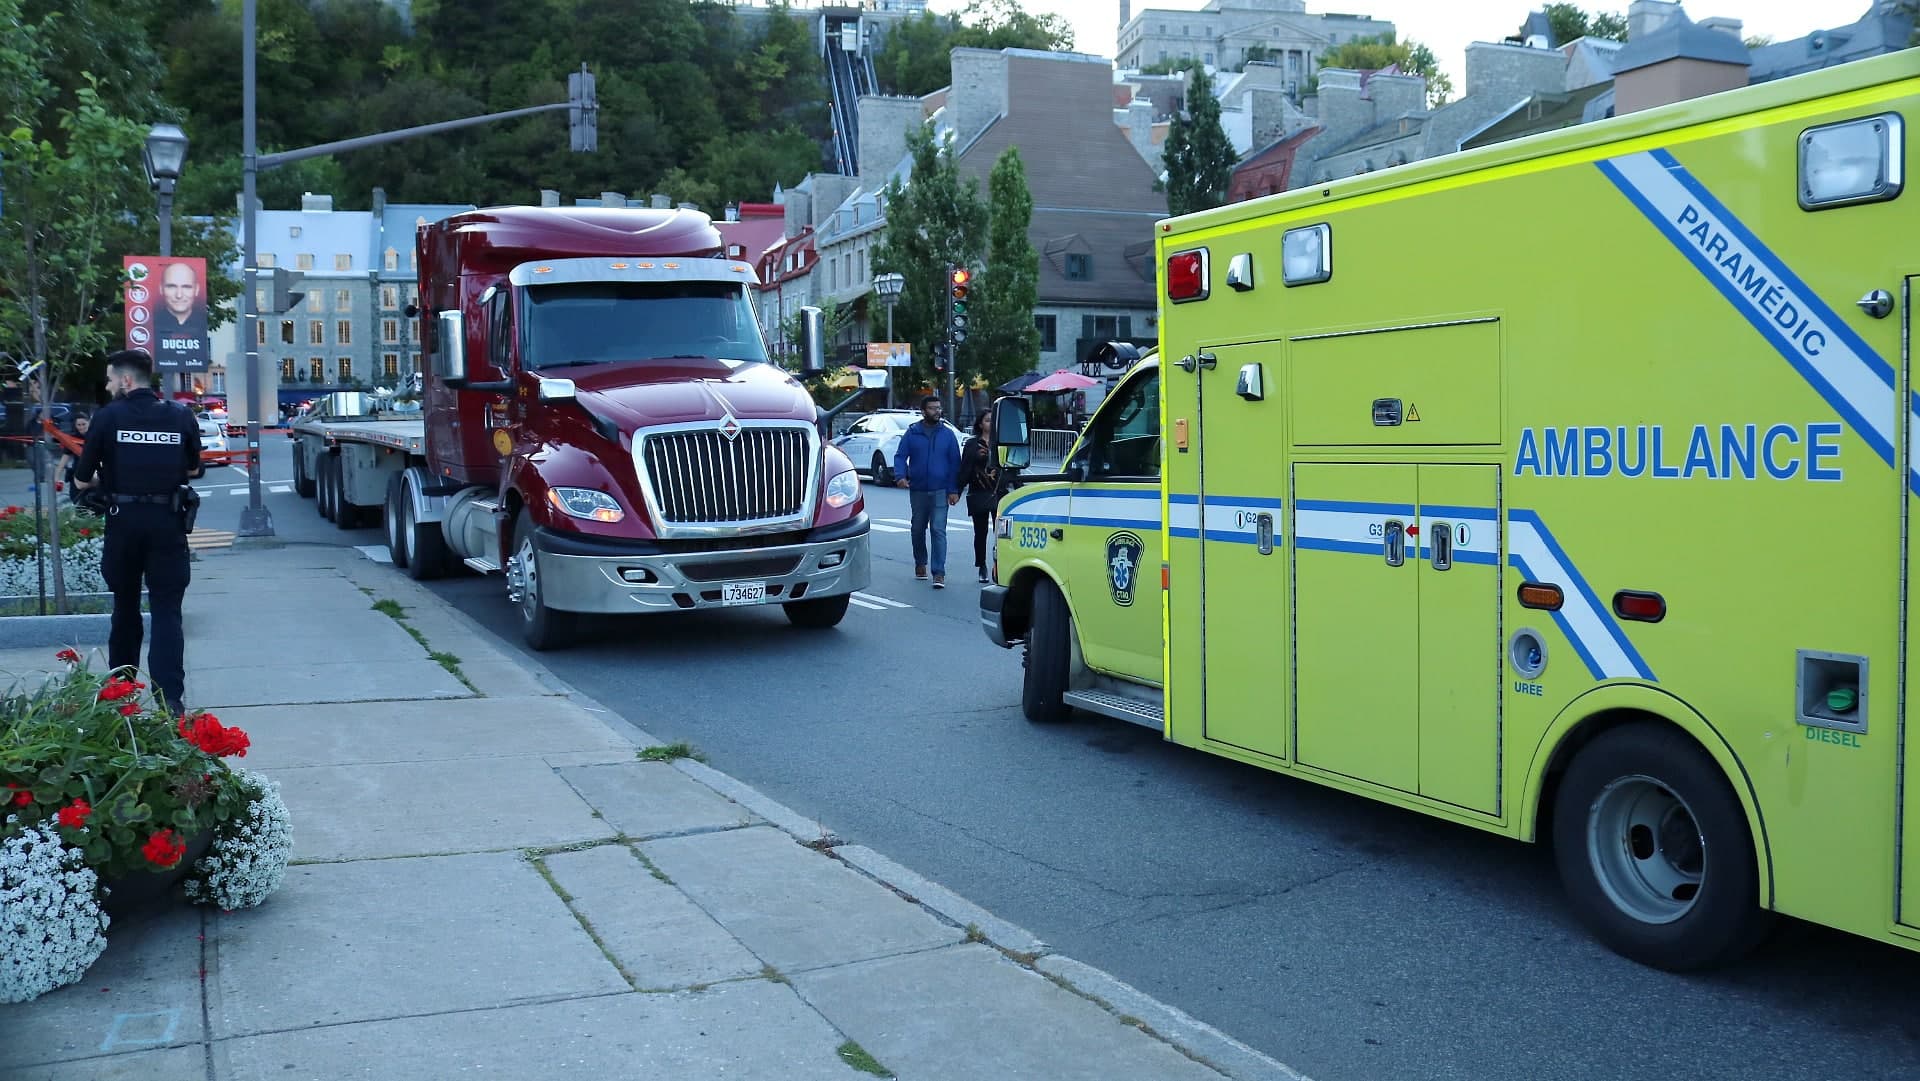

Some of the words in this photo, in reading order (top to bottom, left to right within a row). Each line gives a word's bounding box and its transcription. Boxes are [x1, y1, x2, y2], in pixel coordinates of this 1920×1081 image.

[1677, 204, 1826, 357] PARAMÉDIC
[162, 338, 200, 350] DUCLOS
[120, 432, 179, 443] POLICE
[1513, 422, 1842, 481] AMBULANCE
[1245, 511, 1257, 524] G2
[1019, 526, 1048, 549] 3539
[1369, 523, 1384, 537] G3
[723, 586, 764, 601] L734627
[1806, 727, 1861, 748] DIESEL
